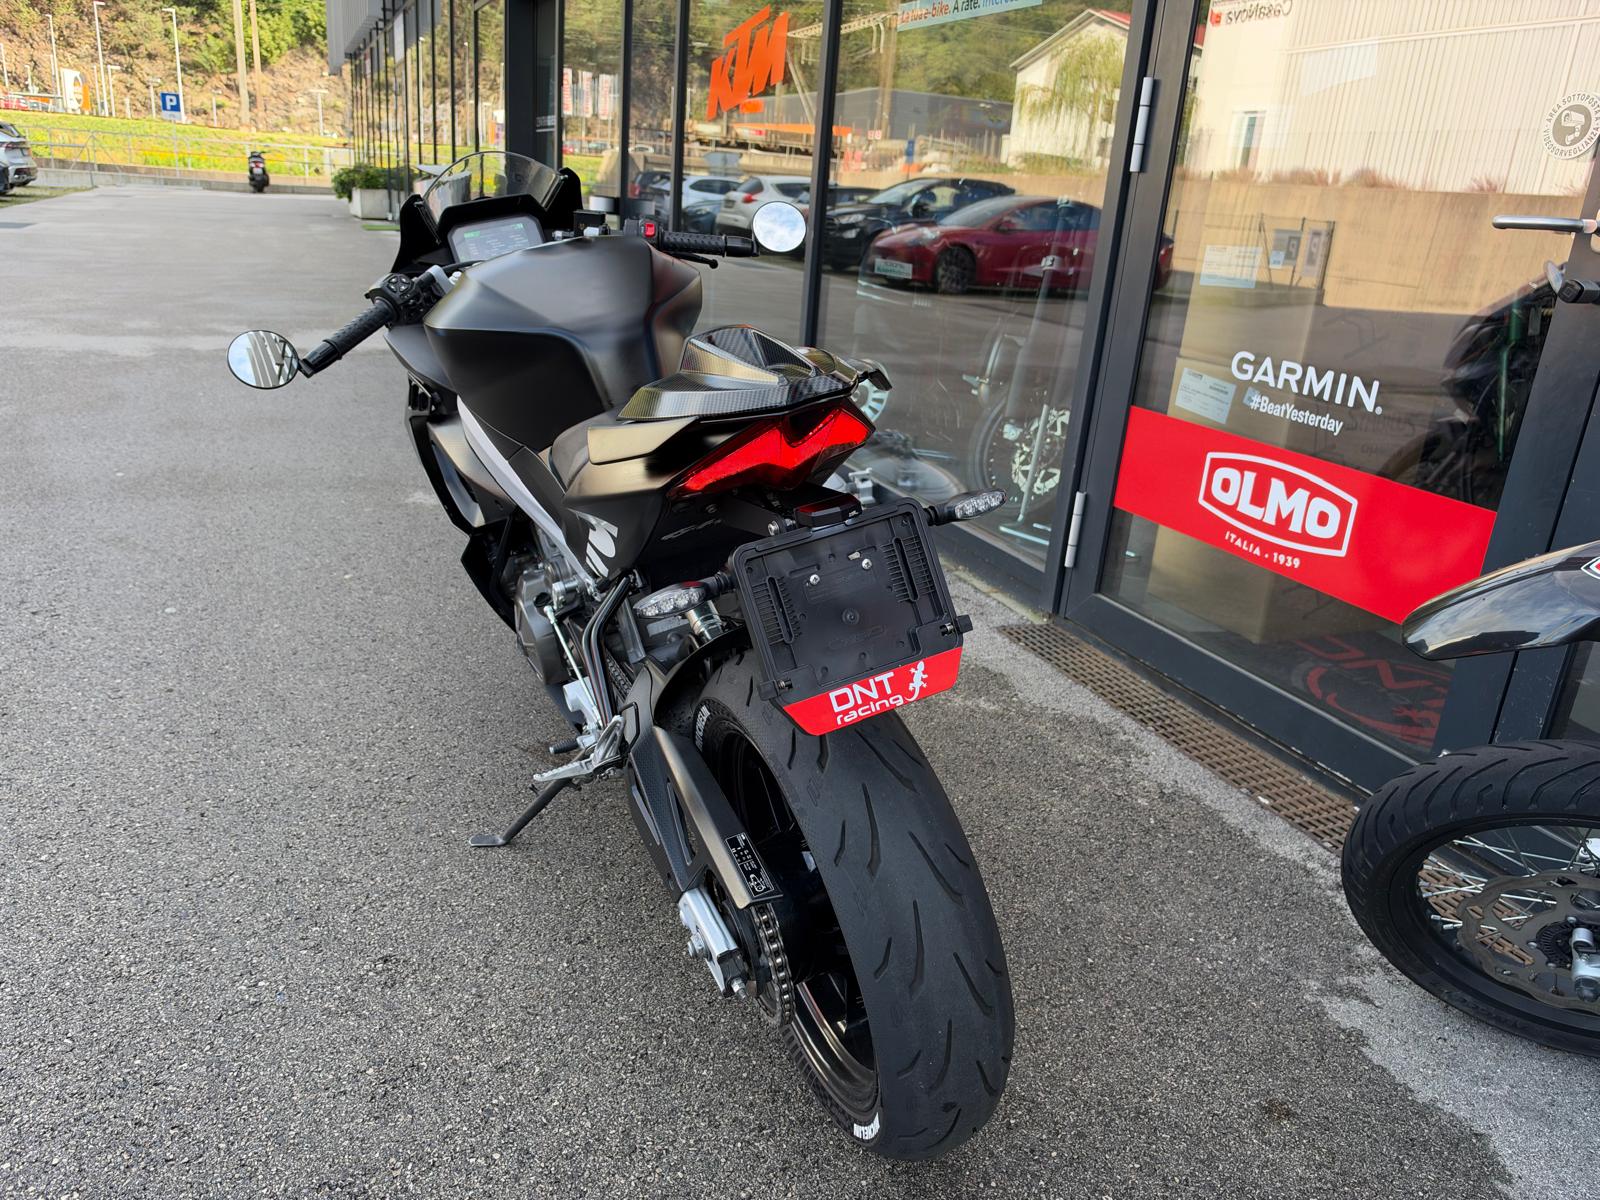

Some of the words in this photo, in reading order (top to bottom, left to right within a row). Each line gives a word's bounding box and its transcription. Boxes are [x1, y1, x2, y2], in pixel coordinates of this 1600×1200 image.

[952, 0, 960, 13] A
[706, 3, 790, 121] KTM
[165, 95, 177, 110] P
[1546, 103, 1562, 123] AREA
[1543, 126, 1600, 157] VIDEOSORVEGLIANZA
[1249, 393, 1344, 436] #BeatYesterday
[1211, 467, 1341, 539] OLMO
[1224, 530, 1261, 557] ITALIA
[1272, 552, 1301, 569] 1939
[828, 671, 895, 713] DNT
[836, 694, 905, 725] racing
